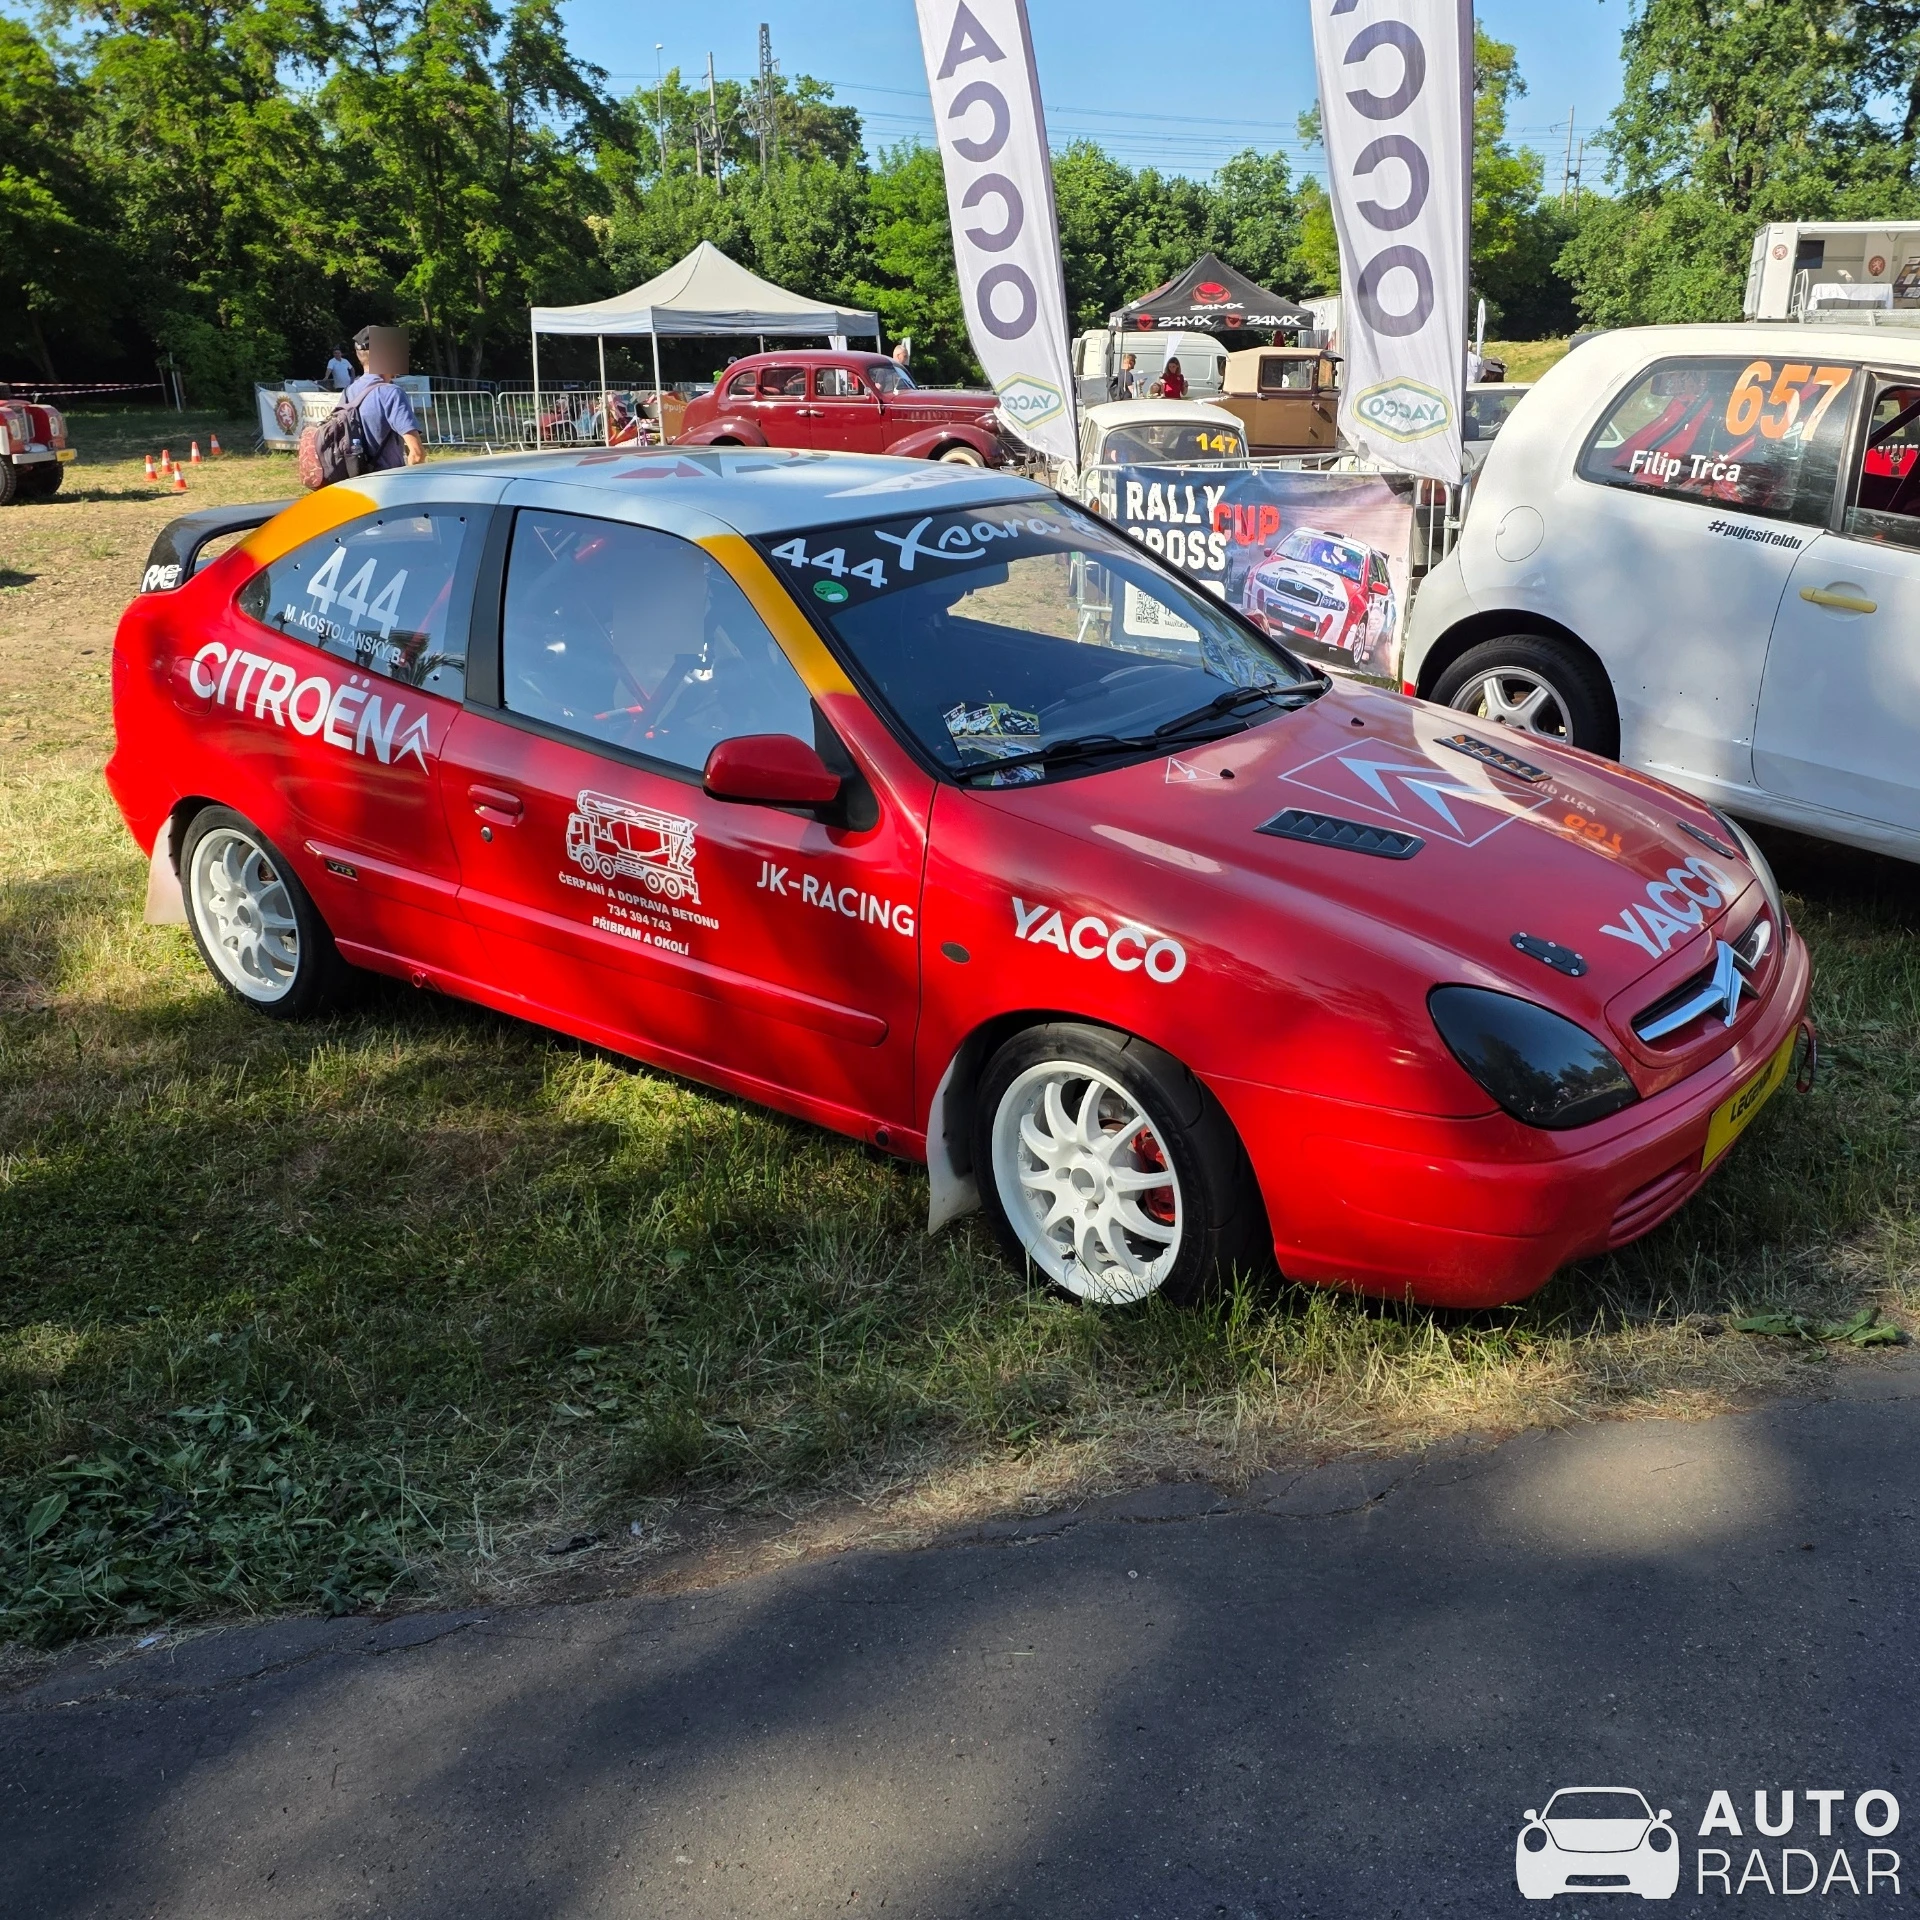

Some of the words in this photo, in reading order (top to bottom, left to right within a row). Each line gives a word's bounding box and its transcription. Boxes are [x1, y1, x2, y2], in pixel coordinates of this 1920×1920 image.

[1158, 315, 1213, 327] 24MX
[1190, 302, 1245, 311] 24MX
[1246, 315, 1302, 326] 24MX
[1725, 360, 1853, 442] 657
[1196, 432, 1238, 454] 147
[1629, 450, 1681, 482] Filip
[1690, 454, 1741, 482] Trča
[1126, 481, 1226, 524] RALLY
[1213, 503, 1281, 546] CUP
[1708, 520, 1802, 550] #pujcsifeldu
[771, 537, 888, 588] 444
[874, 516, 1060, 571] Xsara
[307, 546, 409, 639] 444
[284, 604, 297, 622] M.
[189, 641, 405, 764] CITROËN
[329, 862, 353, 876] VTS
[558, 871, 605, 895] ČERPANÍ
[608, 887, 616, 899] A
[618, 891, 670, 915] DOPRAVA
[672, 907, 719, 930] BETONU
[756, 860, 915, 937] JK-RACING
[1599, 856, 1737, 959] YACCO
[607, 903, 627, 918] 734
[629, 910, 649, 925] 394
[651, 917, 672, 932] 743
[643, 934, 651, 944] A
[654, 935, 689, 956] OKOLÍ
[1012, 896, 1187, 983] YACCO
